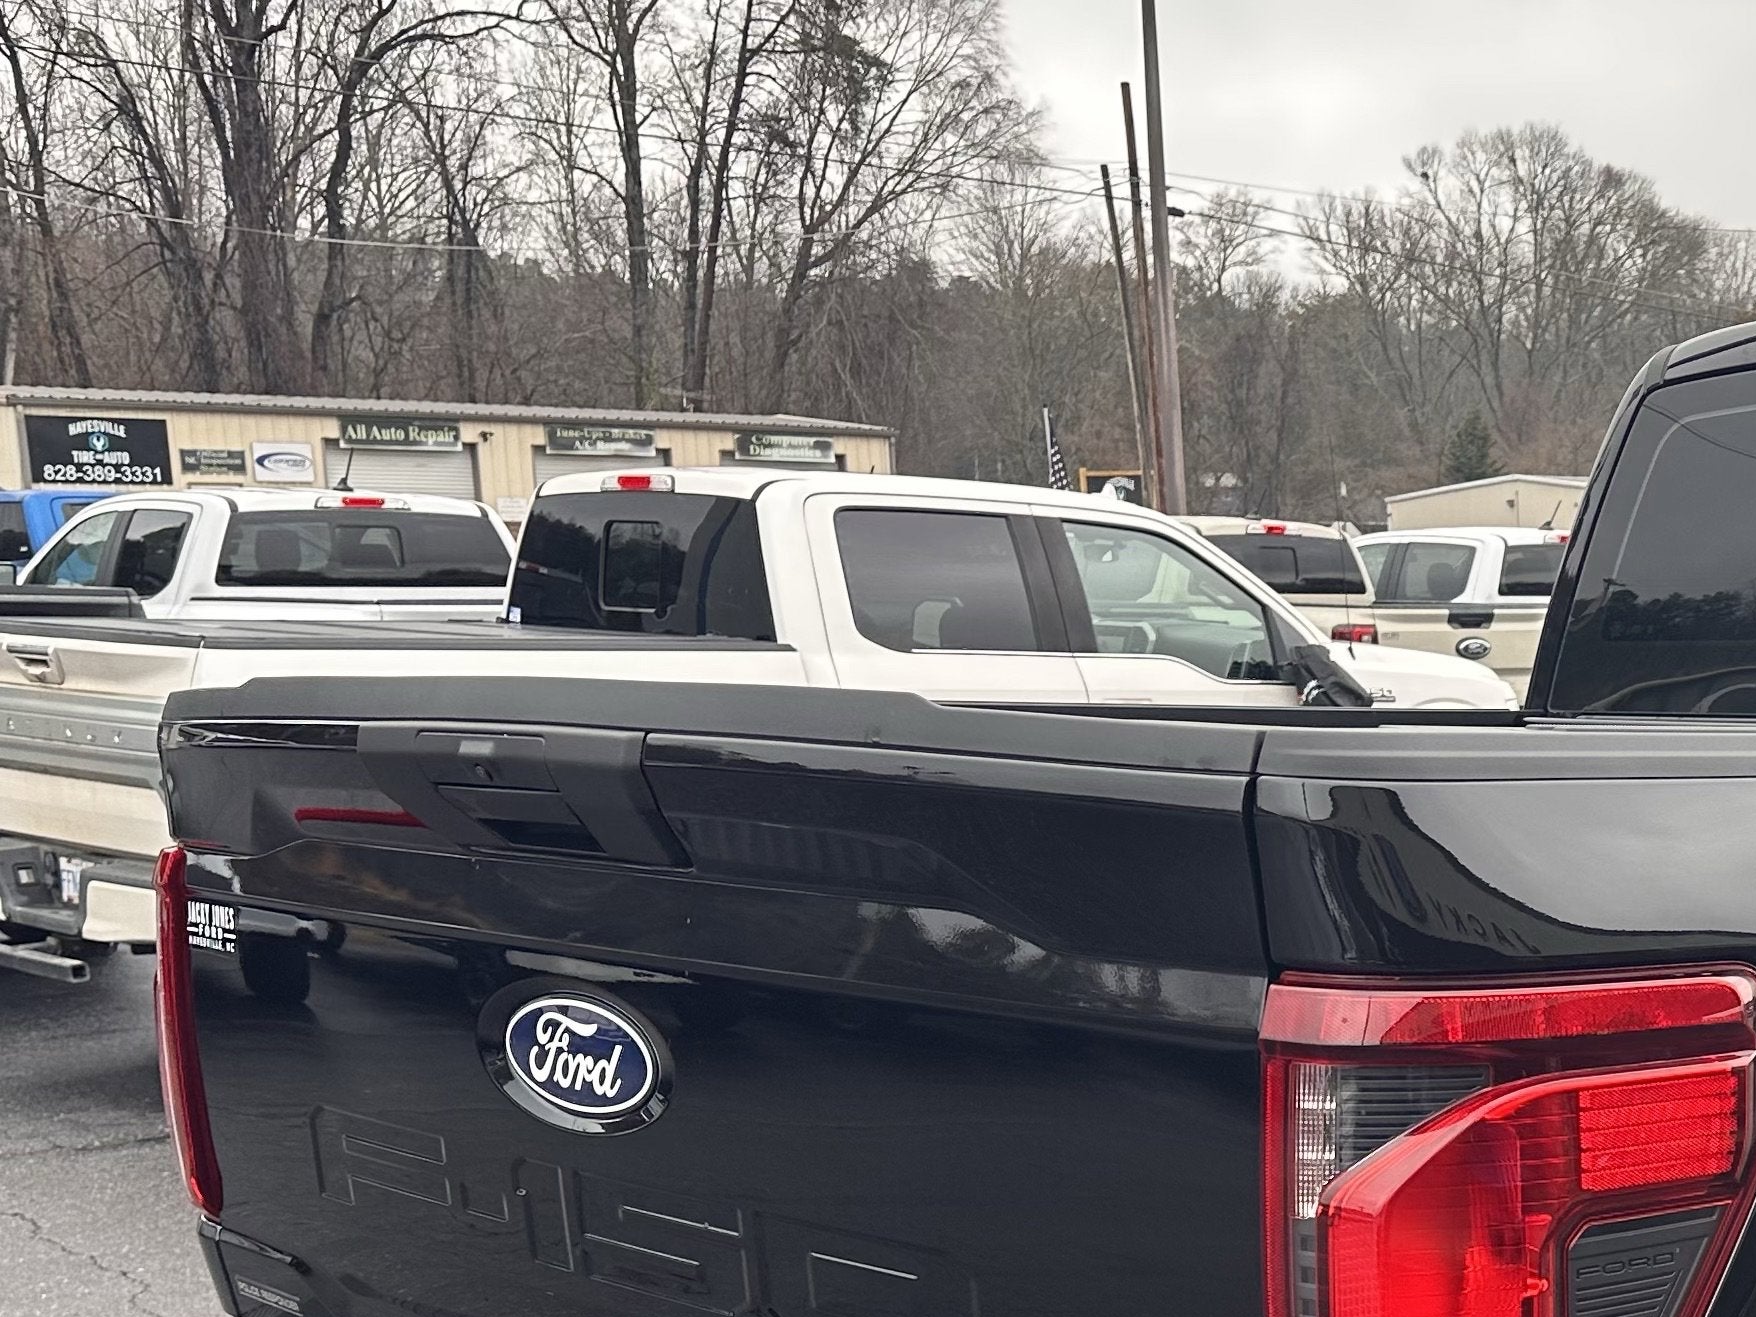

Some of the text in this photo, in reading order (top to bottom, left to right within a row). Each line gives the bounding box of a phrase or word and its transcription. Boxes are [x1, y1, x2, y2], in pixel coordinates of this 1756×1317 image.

[68, 419, 127, 438] HAYESVILLE
[344, 423, 457, 445] All Auto Repair
[43, 464, 162, 482] 828-389-3331
[187, 900, 235, 930] JACKY JONES
[198, 923, 224, 940] FORD
[529, 1011, 623, 1098] Ford
[1576, 1251, 1675, 1281] FORD
